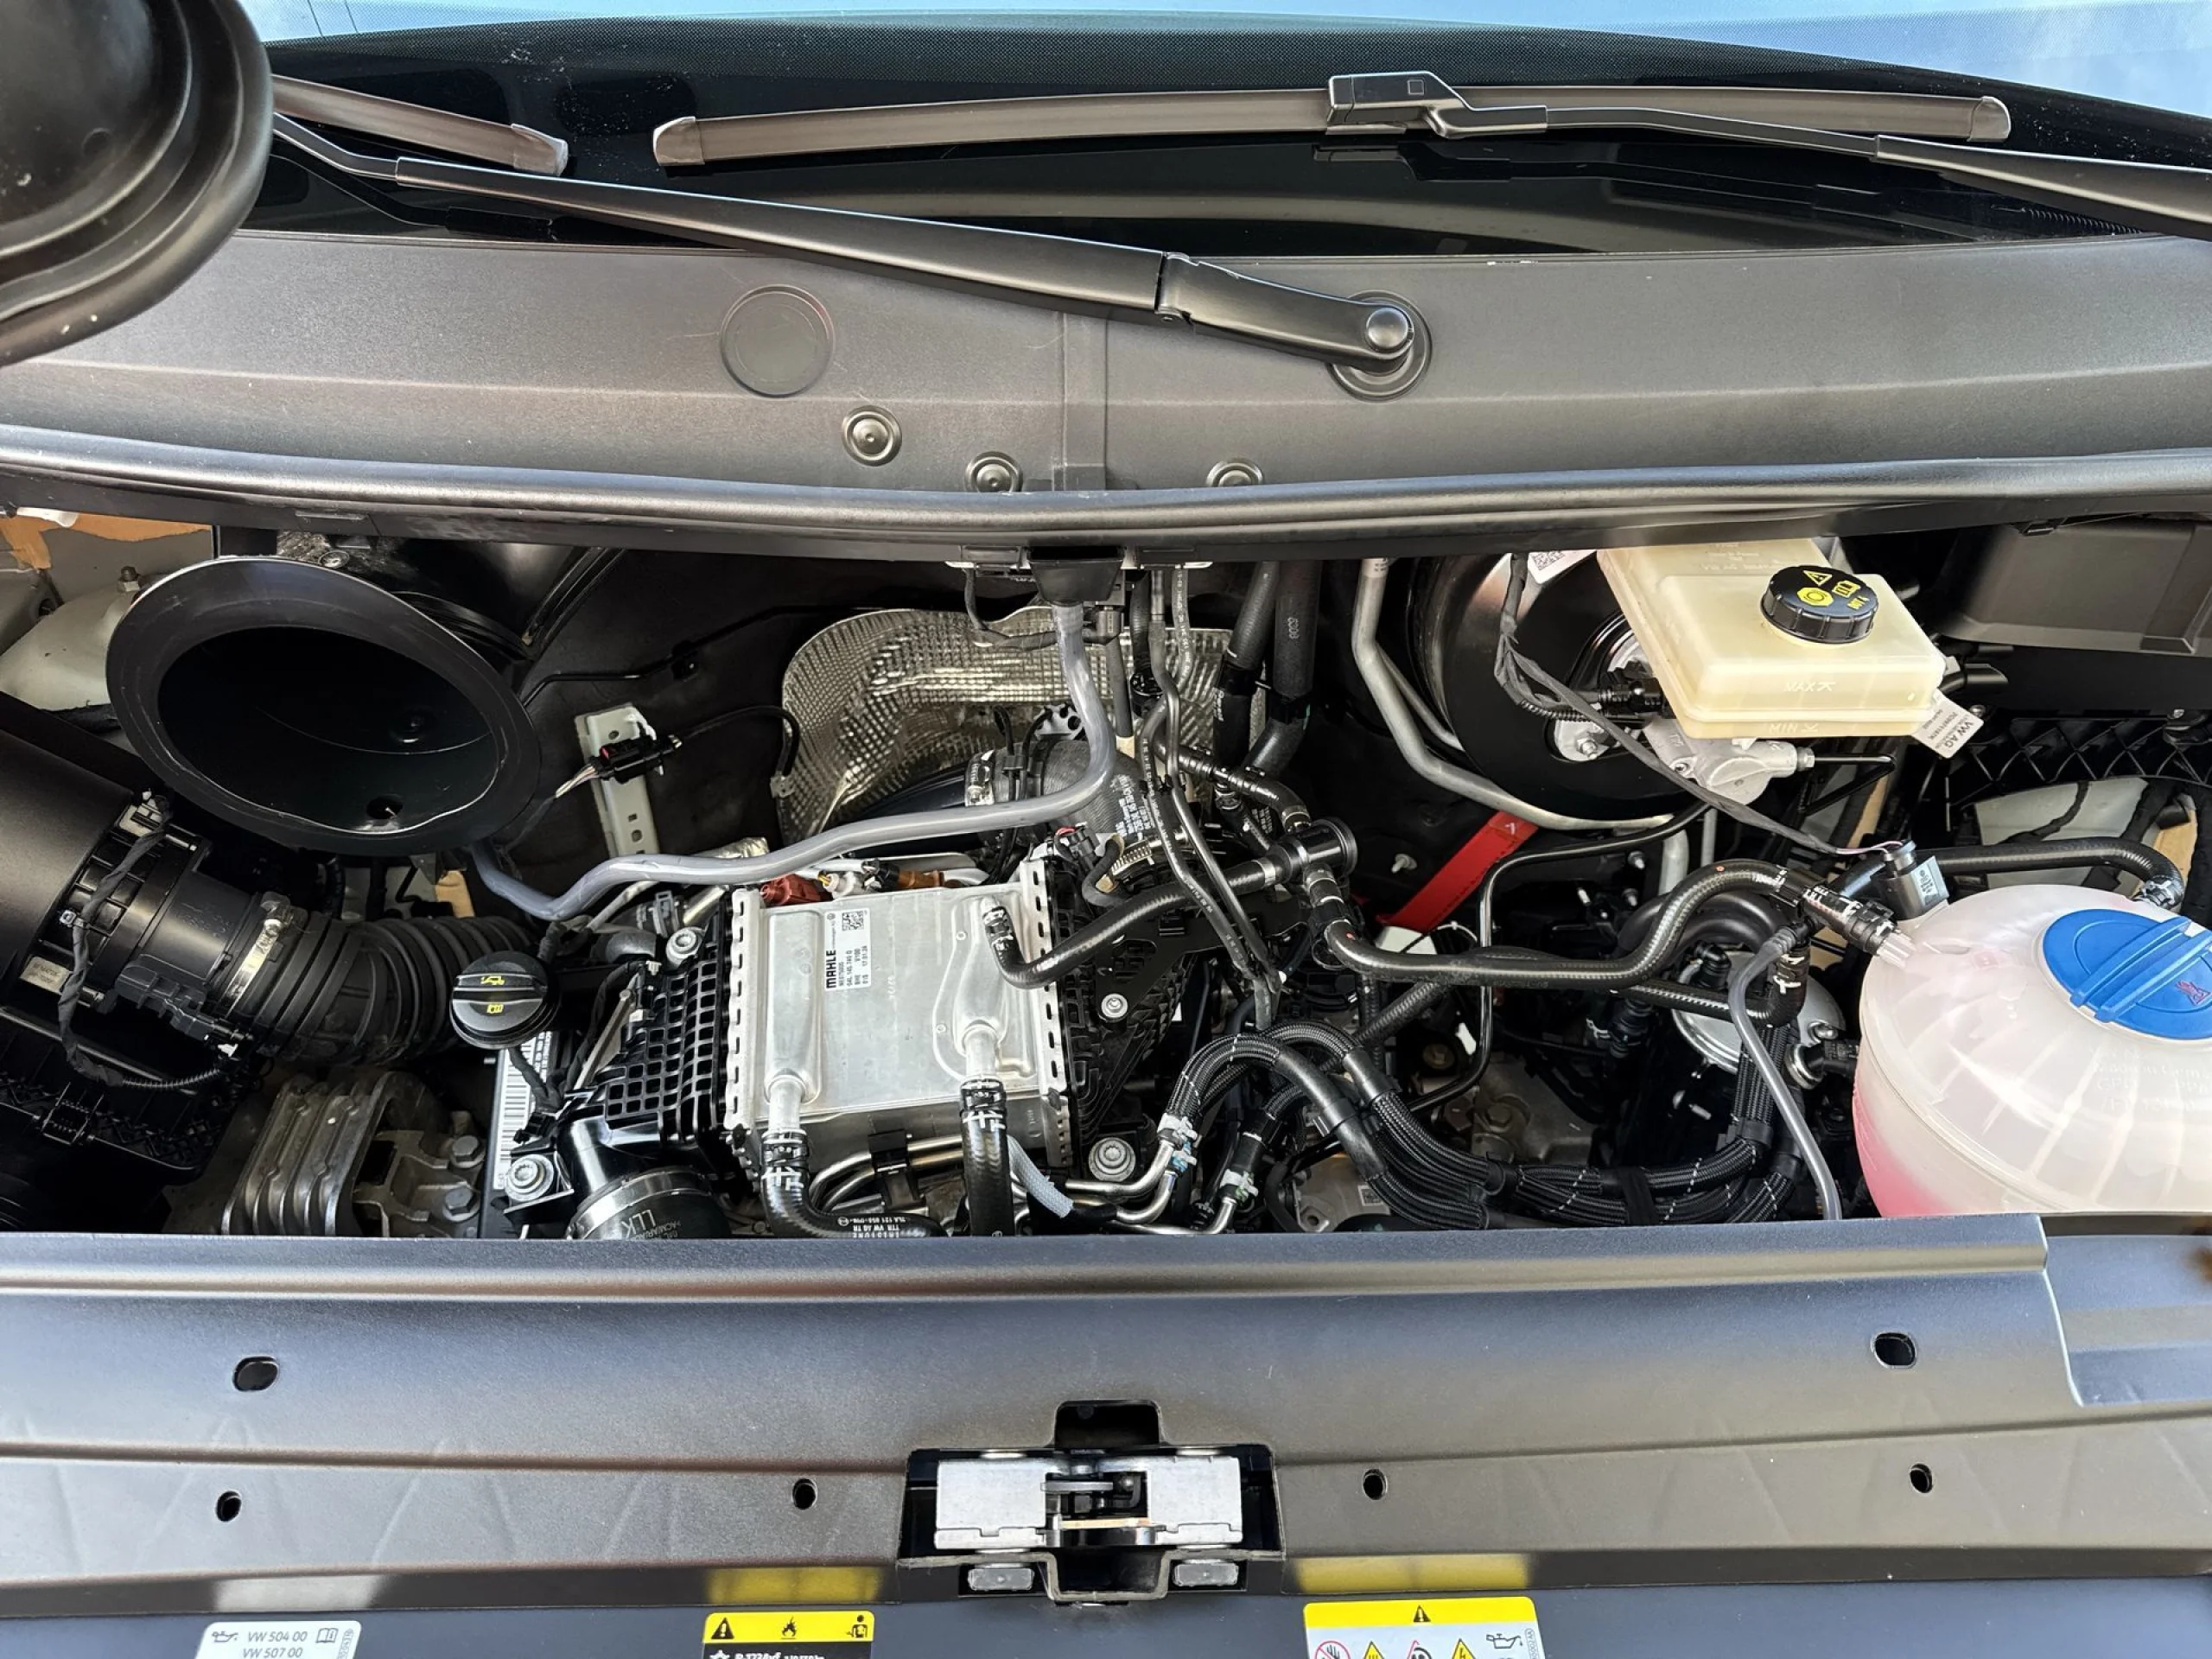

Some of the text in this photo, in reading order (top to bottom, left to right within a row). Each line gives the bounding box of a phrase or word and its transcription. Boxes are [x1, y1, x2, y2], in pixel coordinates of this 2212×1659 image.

[1769, 722, 1798, 734] MIN
[1957, 721, 1974, 736] VW
[825, 950, 836, 989] MAHLE
[621, 1209, 656, 1241] LLK
[248, 1631, 308, 1643] VW 504 00
[243, 1648, 303, 1658] VW 507 00
